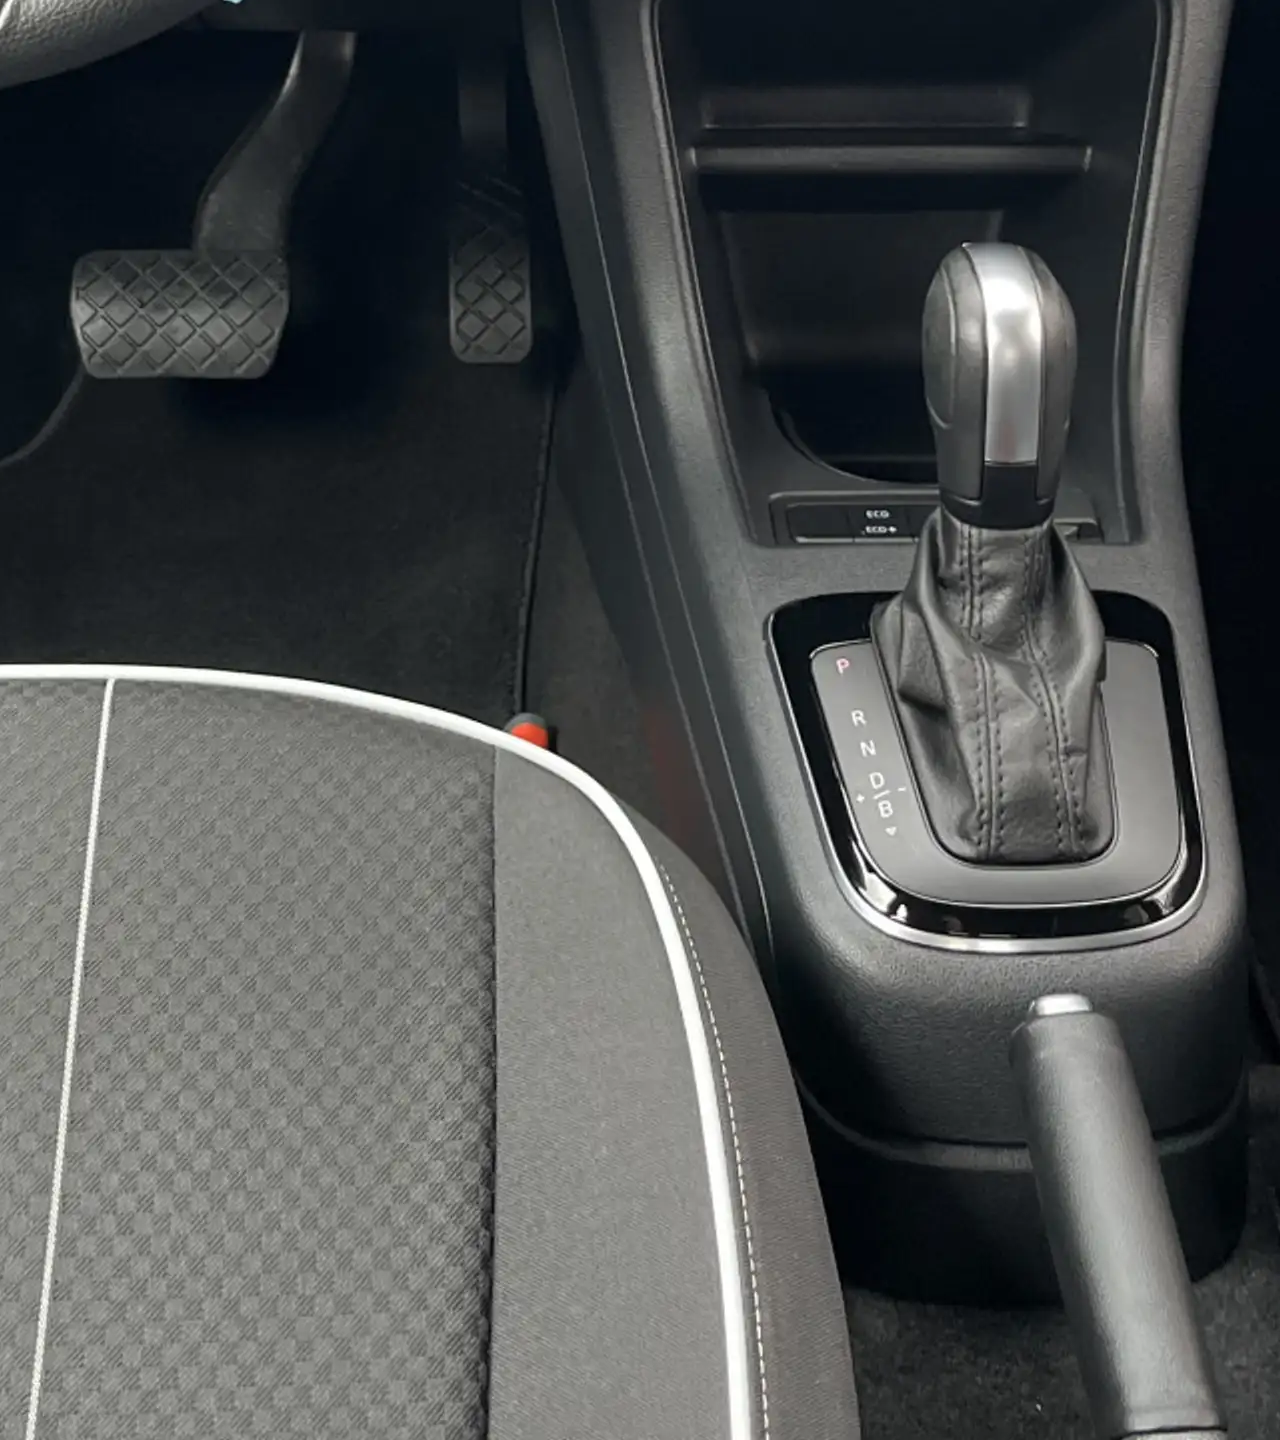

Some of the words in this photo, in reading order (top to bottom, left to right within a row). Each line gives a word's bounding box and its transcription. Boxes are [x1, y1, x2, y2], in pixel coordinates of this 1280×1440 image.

[866, 509, 890, 520] ECO
[836, 658, 850, 674] P
[852, 710, 867, 726] R
[860, 740, 876, 757] N
[869, 772, 885, 789] D
[878, 800, 893, 818] B
